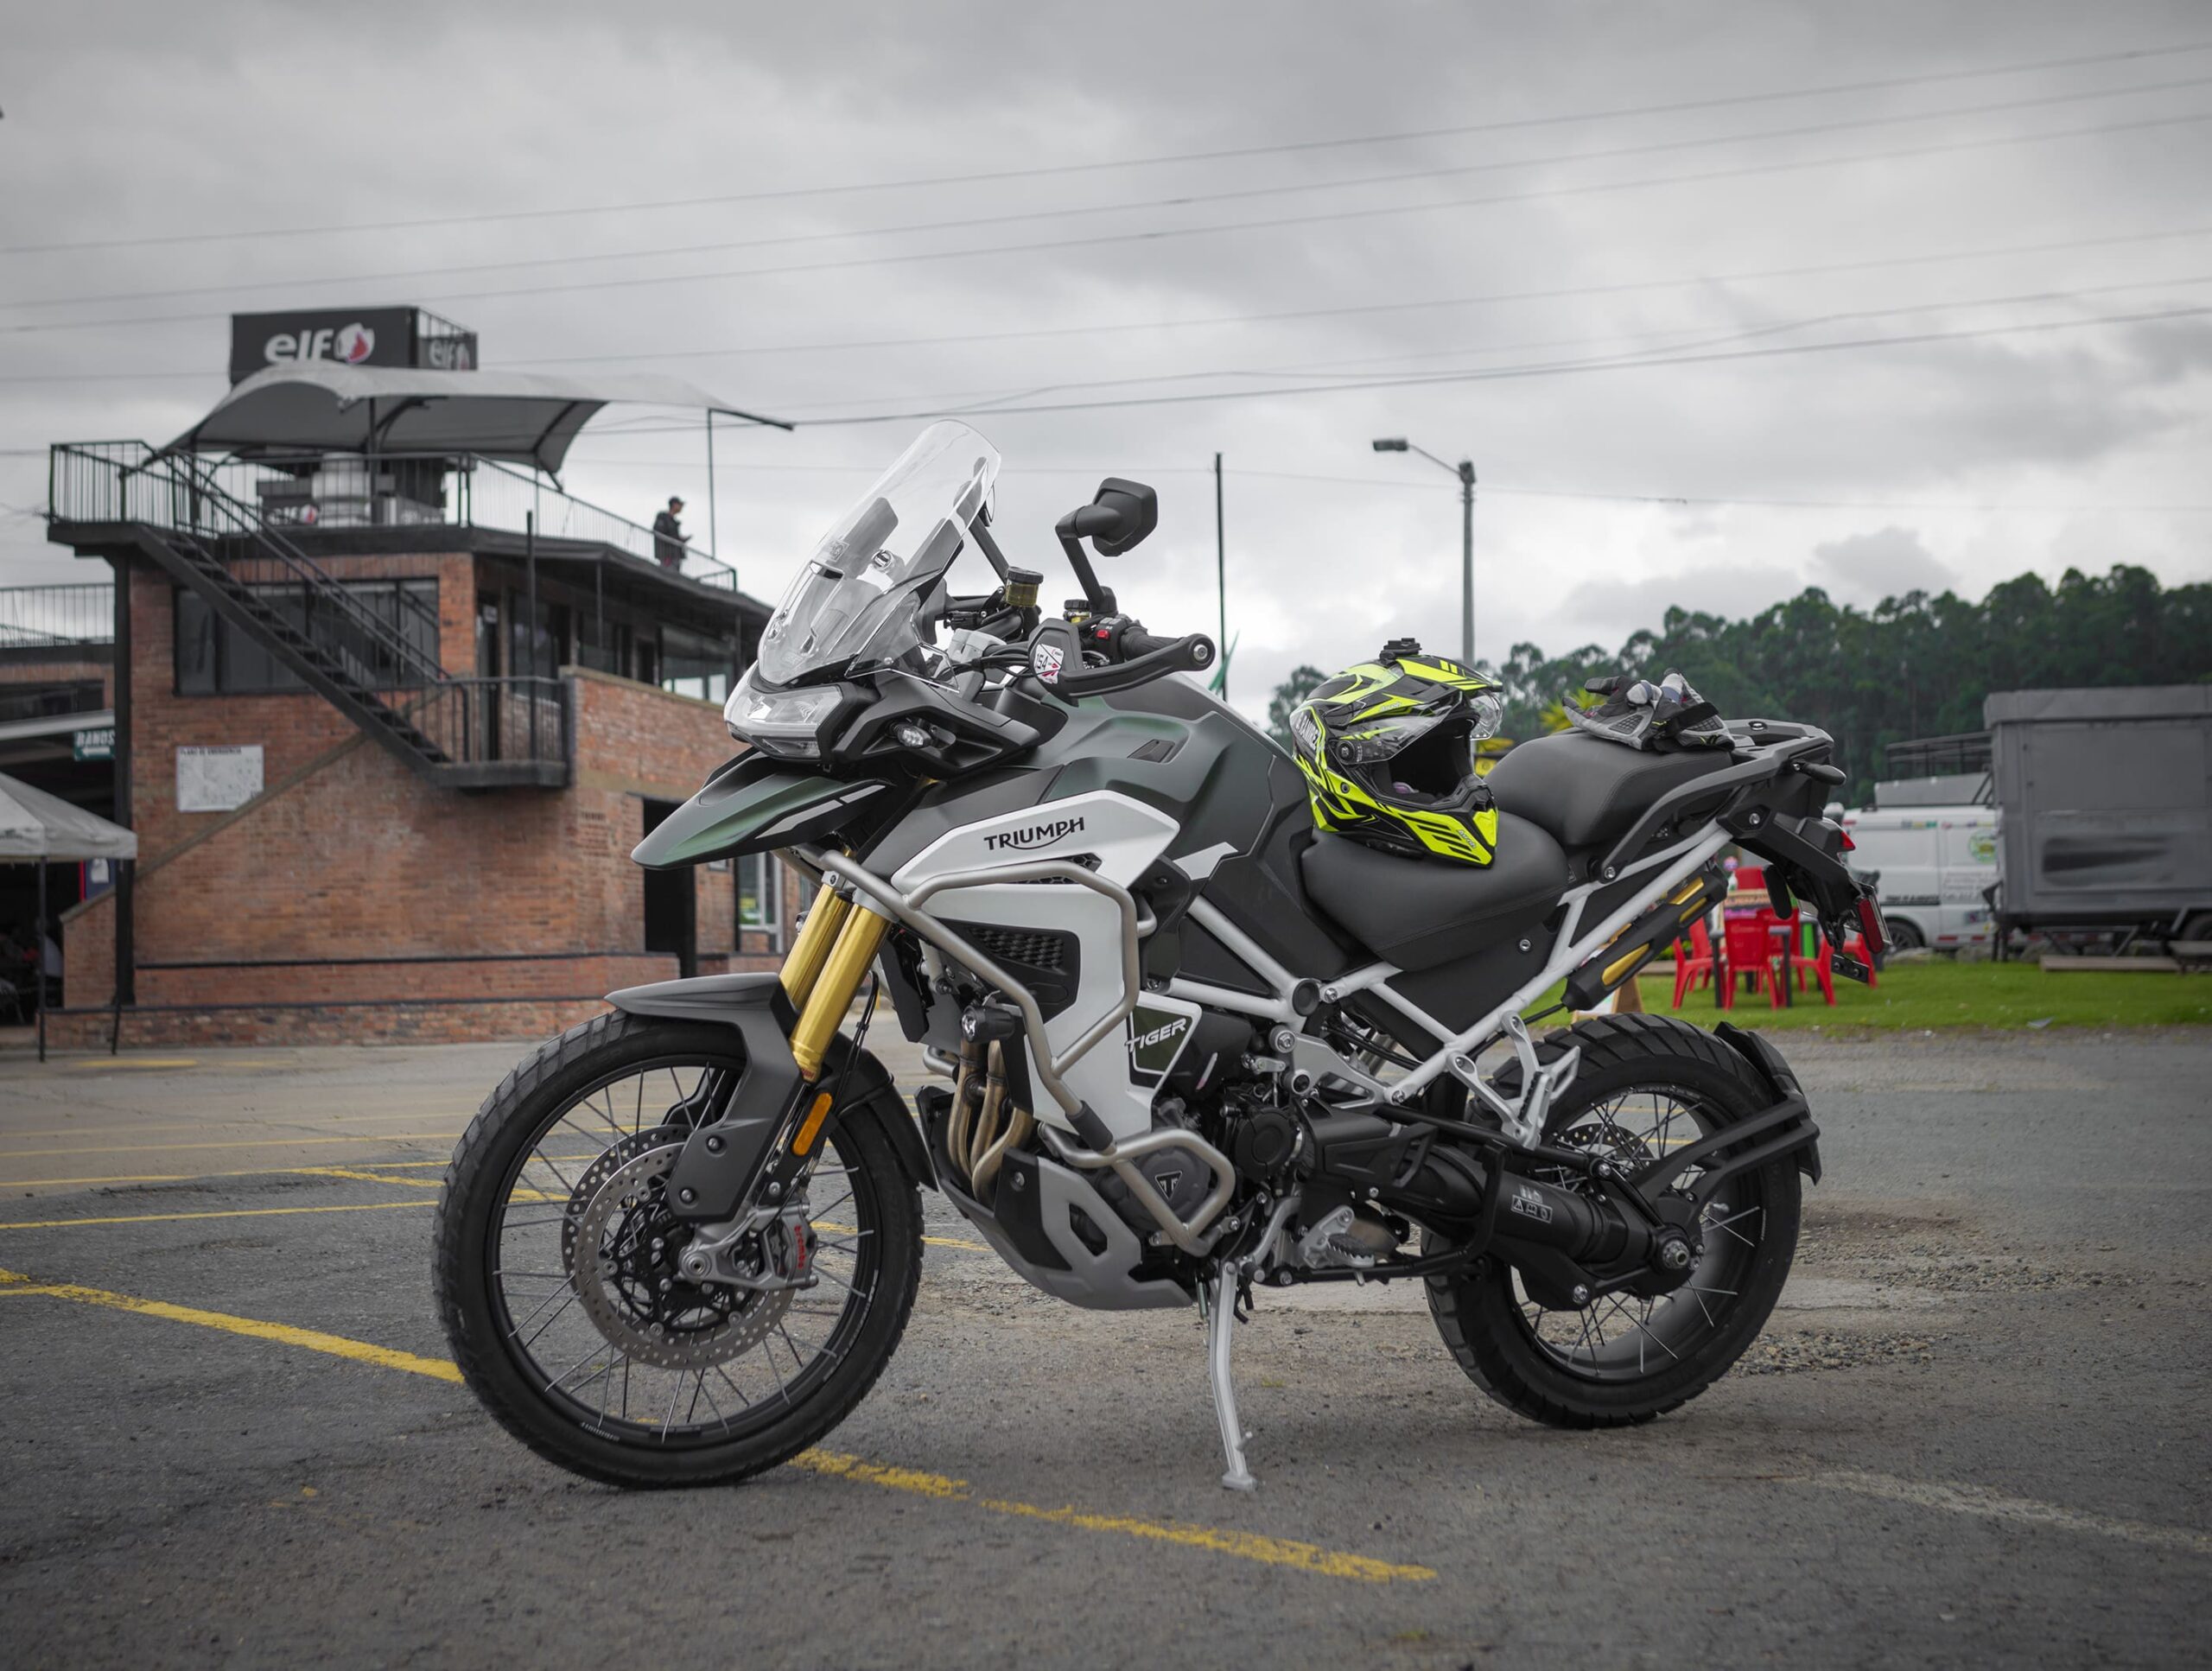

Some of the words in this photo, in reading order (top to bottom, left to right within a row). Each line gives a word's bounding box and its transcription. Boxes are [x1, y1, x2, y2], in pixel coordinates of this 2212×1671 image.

[264, 327, 334, 363] elf
[983, 816, 1084, 850] TRIUMPH
[1124, 1018, 1186, 1053] TIGER
